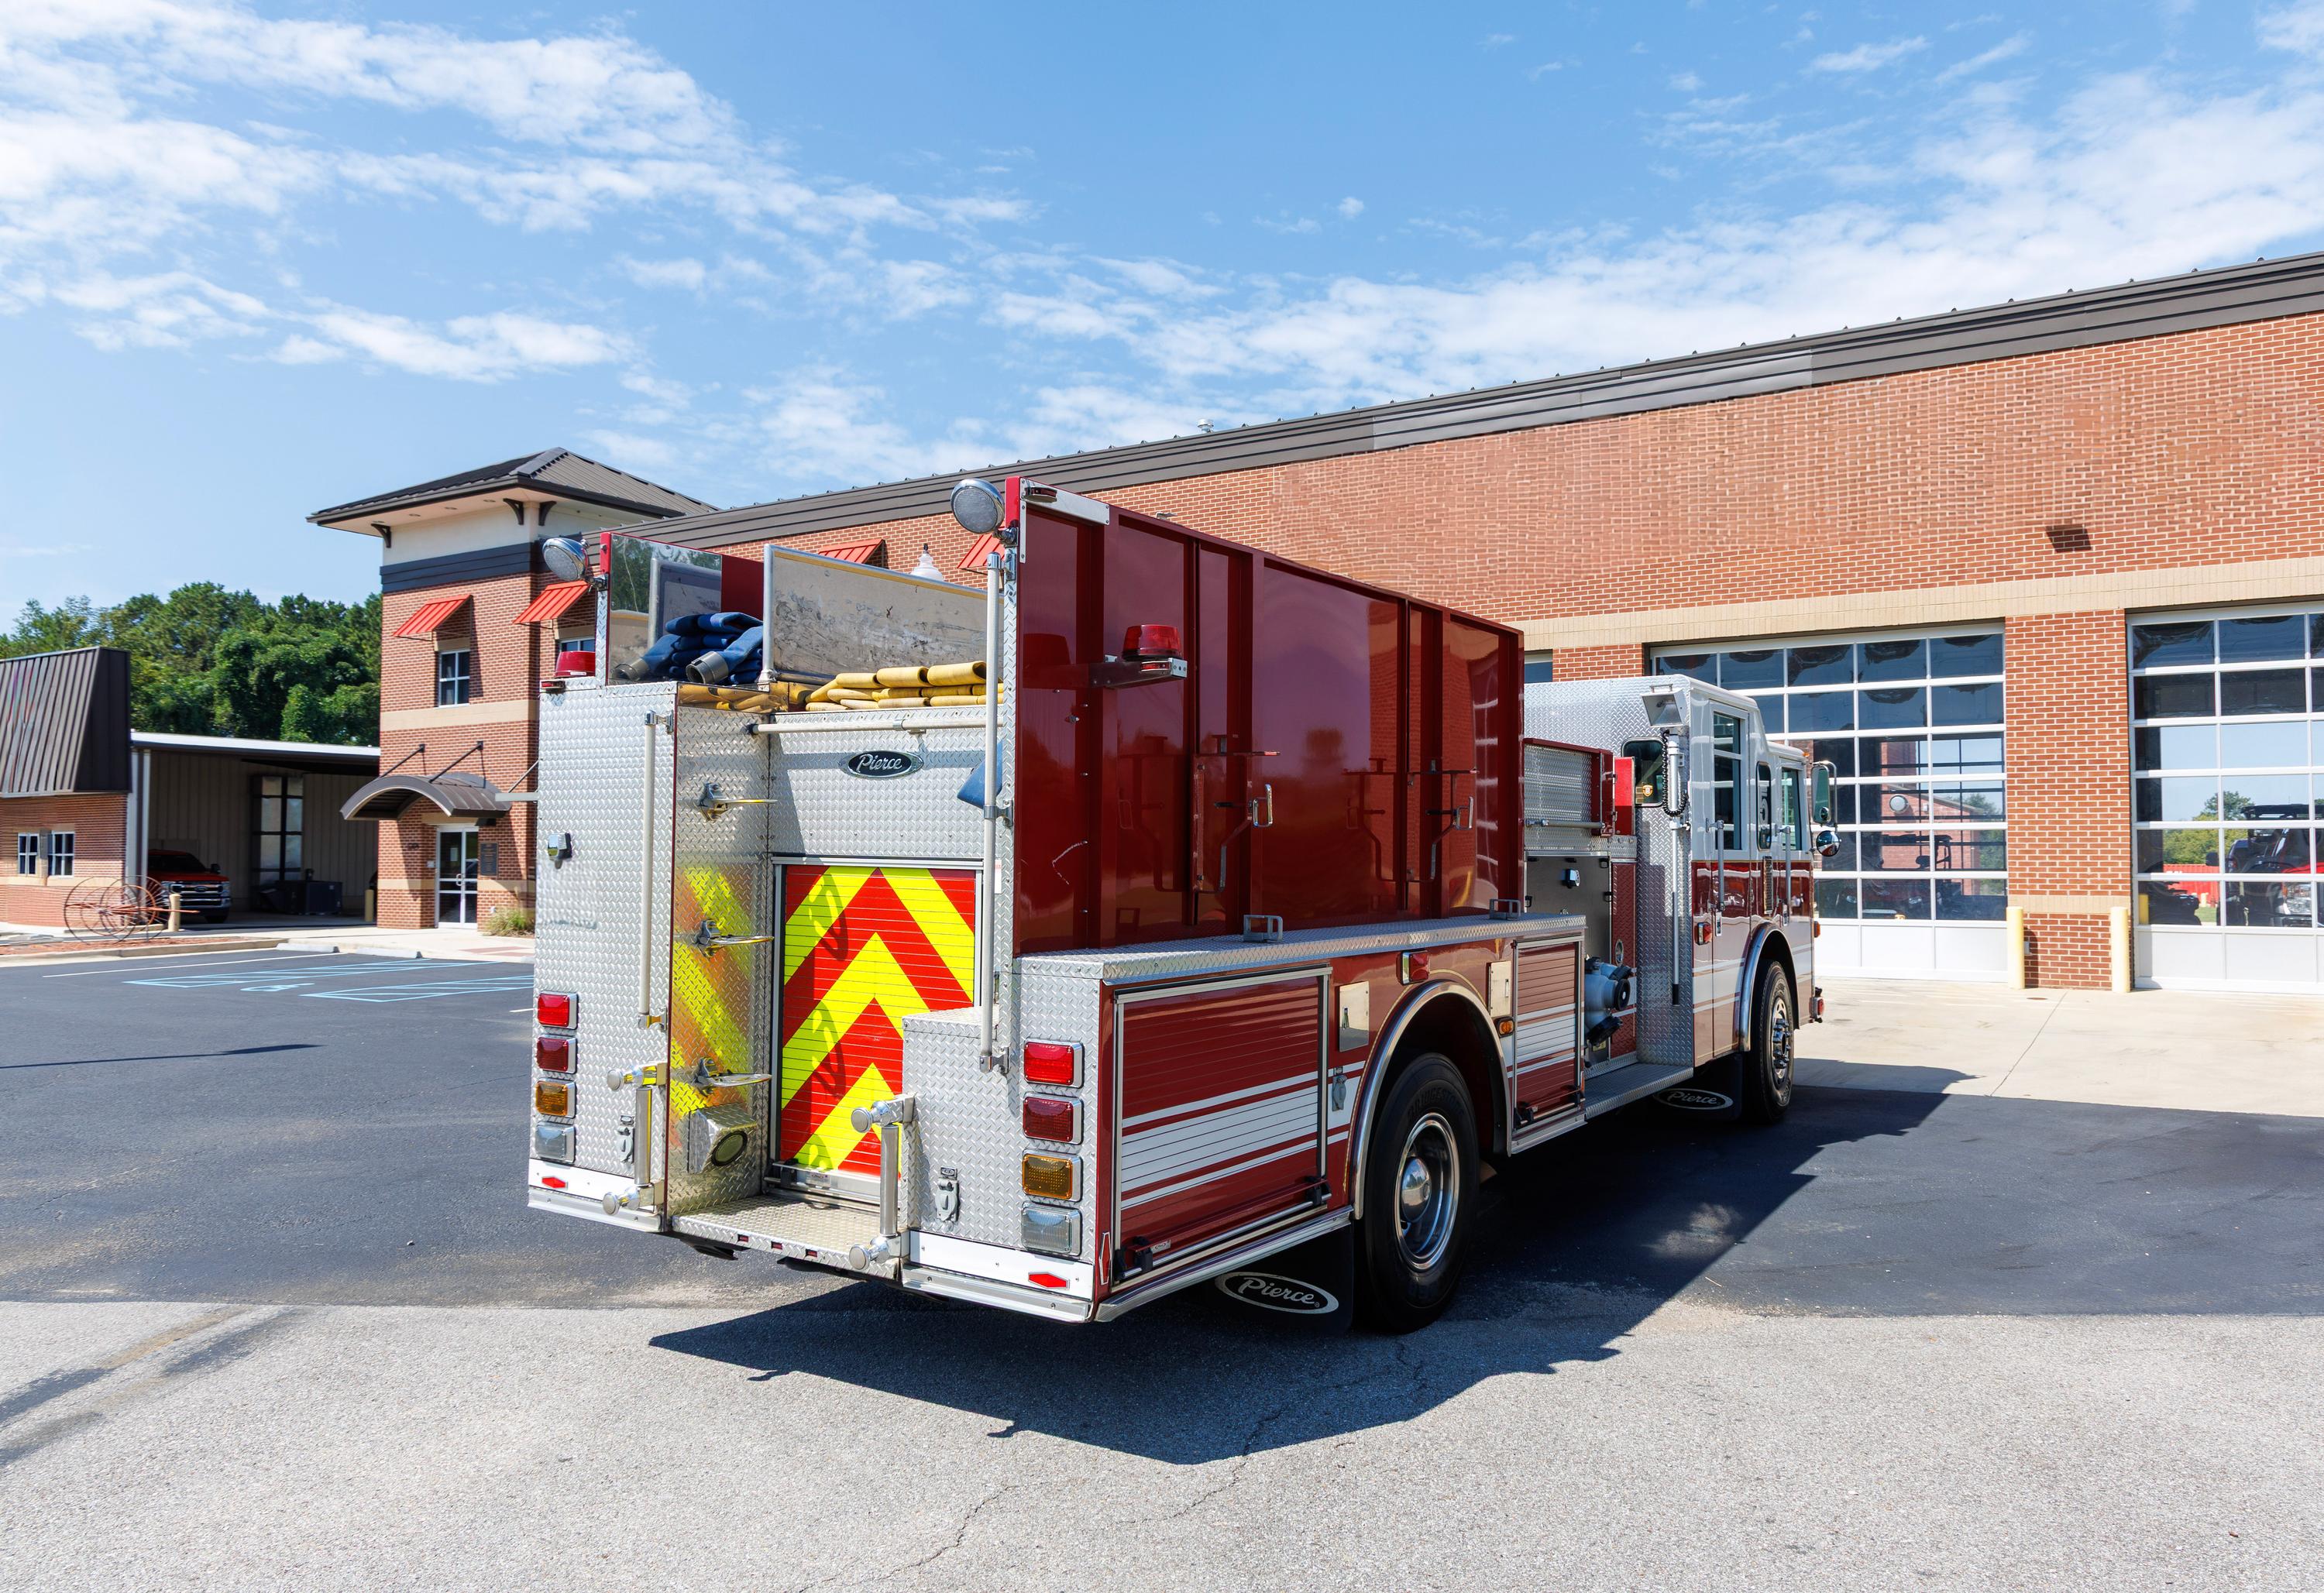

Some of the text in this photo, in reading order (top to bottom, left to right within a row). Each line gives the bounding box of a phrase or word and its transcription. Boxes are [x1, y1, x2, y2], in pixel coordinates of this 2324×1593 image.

[856, 754, 902, 773] Pierce
[1667, 1091, 1717, 1104] Pierce
[1238, 1277, 1315, 1304] Pierce
